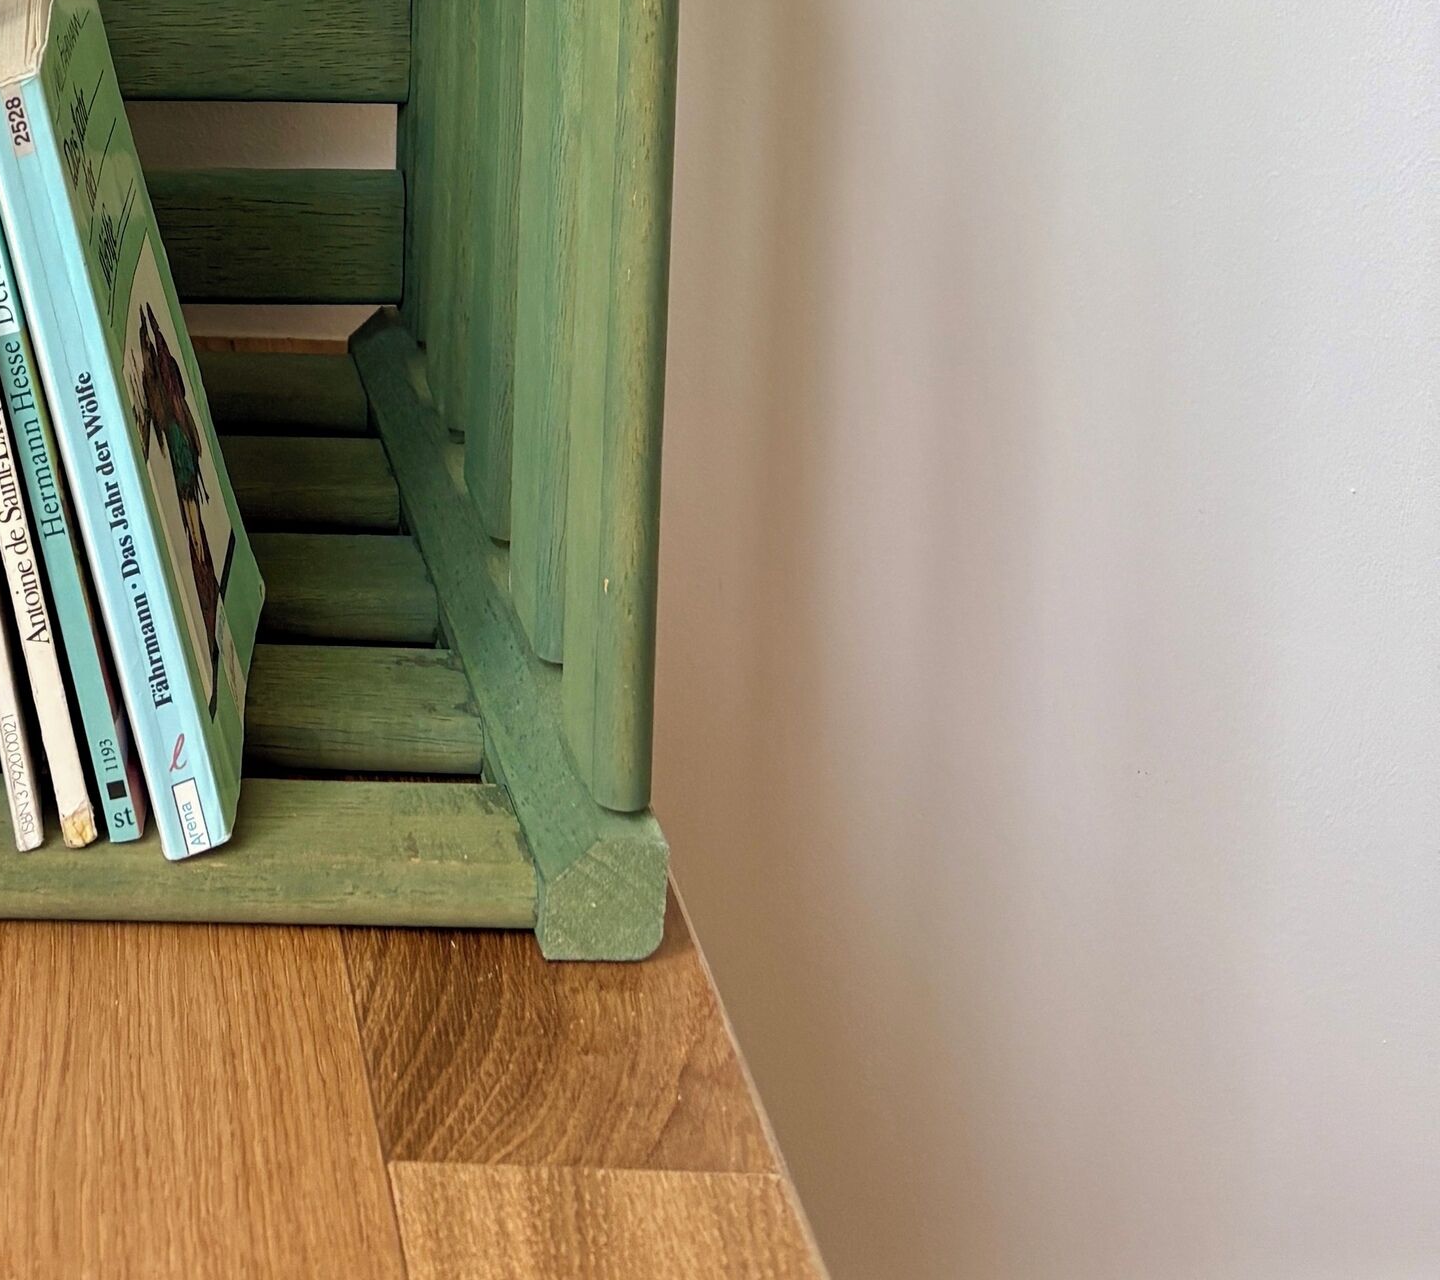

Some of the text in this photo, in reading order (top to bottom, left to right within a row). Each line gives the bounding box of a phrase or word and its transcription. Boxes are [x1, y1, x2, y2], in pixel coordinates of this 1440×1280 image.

[5, 95, 31, 146] 2528
[75, 370, 105, 440] Wölfe
[4, 340, 66, 540] Hermann Hesse
[95, 441, 116, 476] der
[104, 481, 132, 532] Jahr
[4, 527, 29, 557] de
[118, 534, 142, 582] Das
[15, 558, 51, 644] Antoine
[133, 591, 174, 710] Fährmann
[99, 738, 119, 772] 1193
[113, 807, 135, 829] st
[181, 801, 206, 846] Arena
